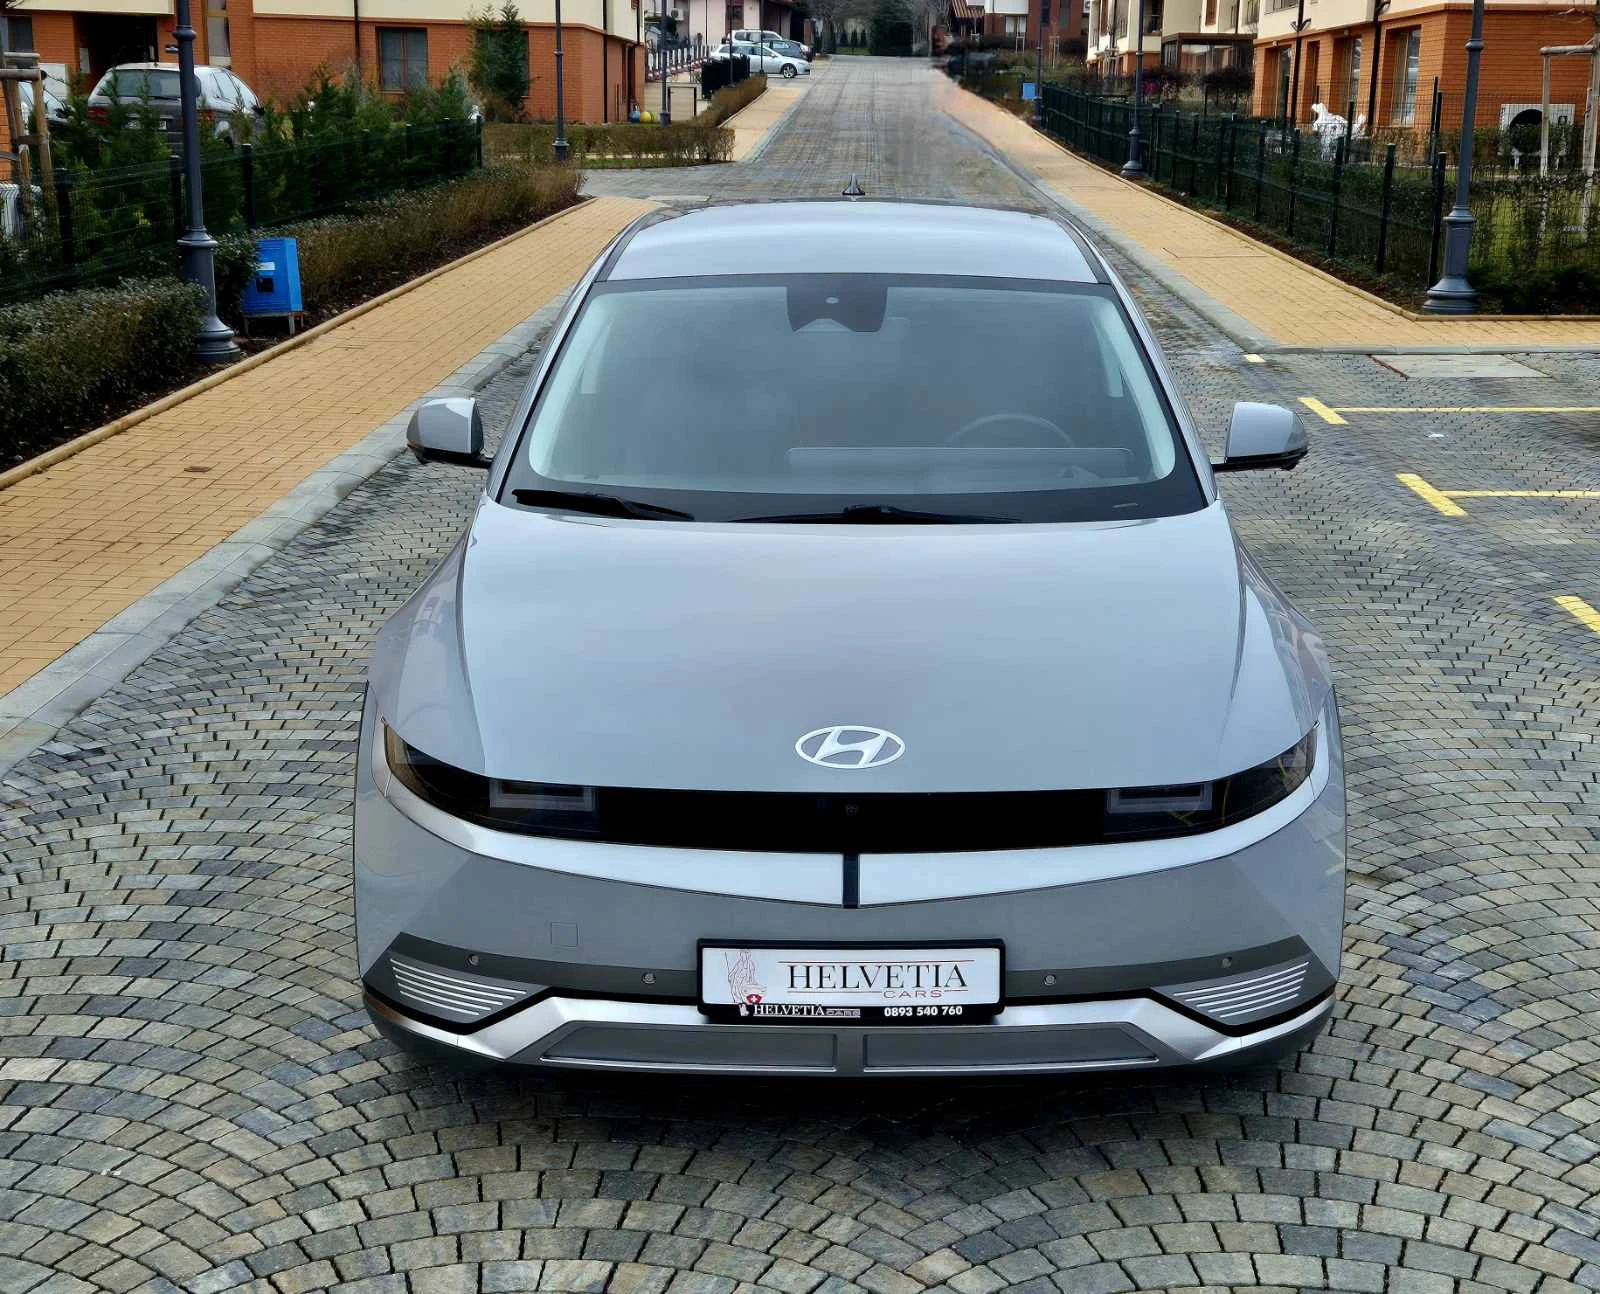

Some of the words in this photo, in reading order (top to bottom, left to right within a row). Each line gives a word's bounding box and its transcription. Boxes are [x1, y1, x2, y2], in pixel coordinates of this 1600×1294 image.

[787, 964, 967, 989] HELVETIA
[883, 989, 942, 999] CARS
[753, 1004, 825, 1016] HELVETIA
[884, 1007, 913, 1017] 0893
[916, 1006, 938, 1016] 540
[941, 1005, 963, 1015] 760
